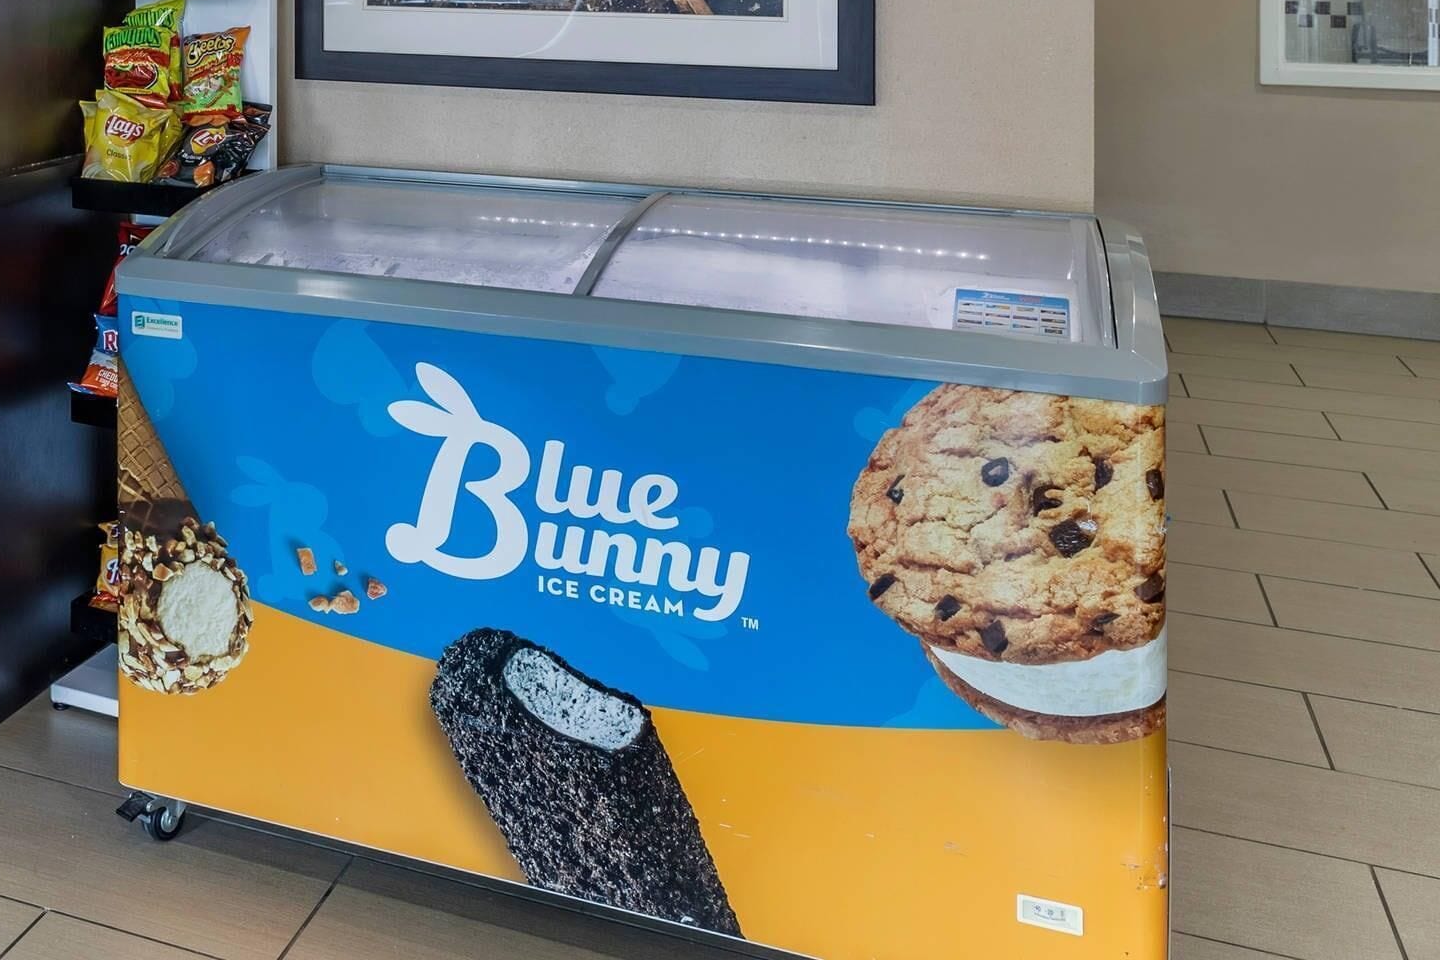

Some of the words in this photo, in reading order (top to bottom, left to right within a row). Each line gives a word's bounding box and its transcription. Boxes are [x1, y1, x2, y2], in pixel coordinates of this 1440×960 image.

[186, 35, 235, 68] Cheetos
[106, 115, 144, 140] Lay's
[146, 316, 178, 326] Excellence
[538, 575, 579, 599] ICE
[589, 584, 685, 617] CREAM
